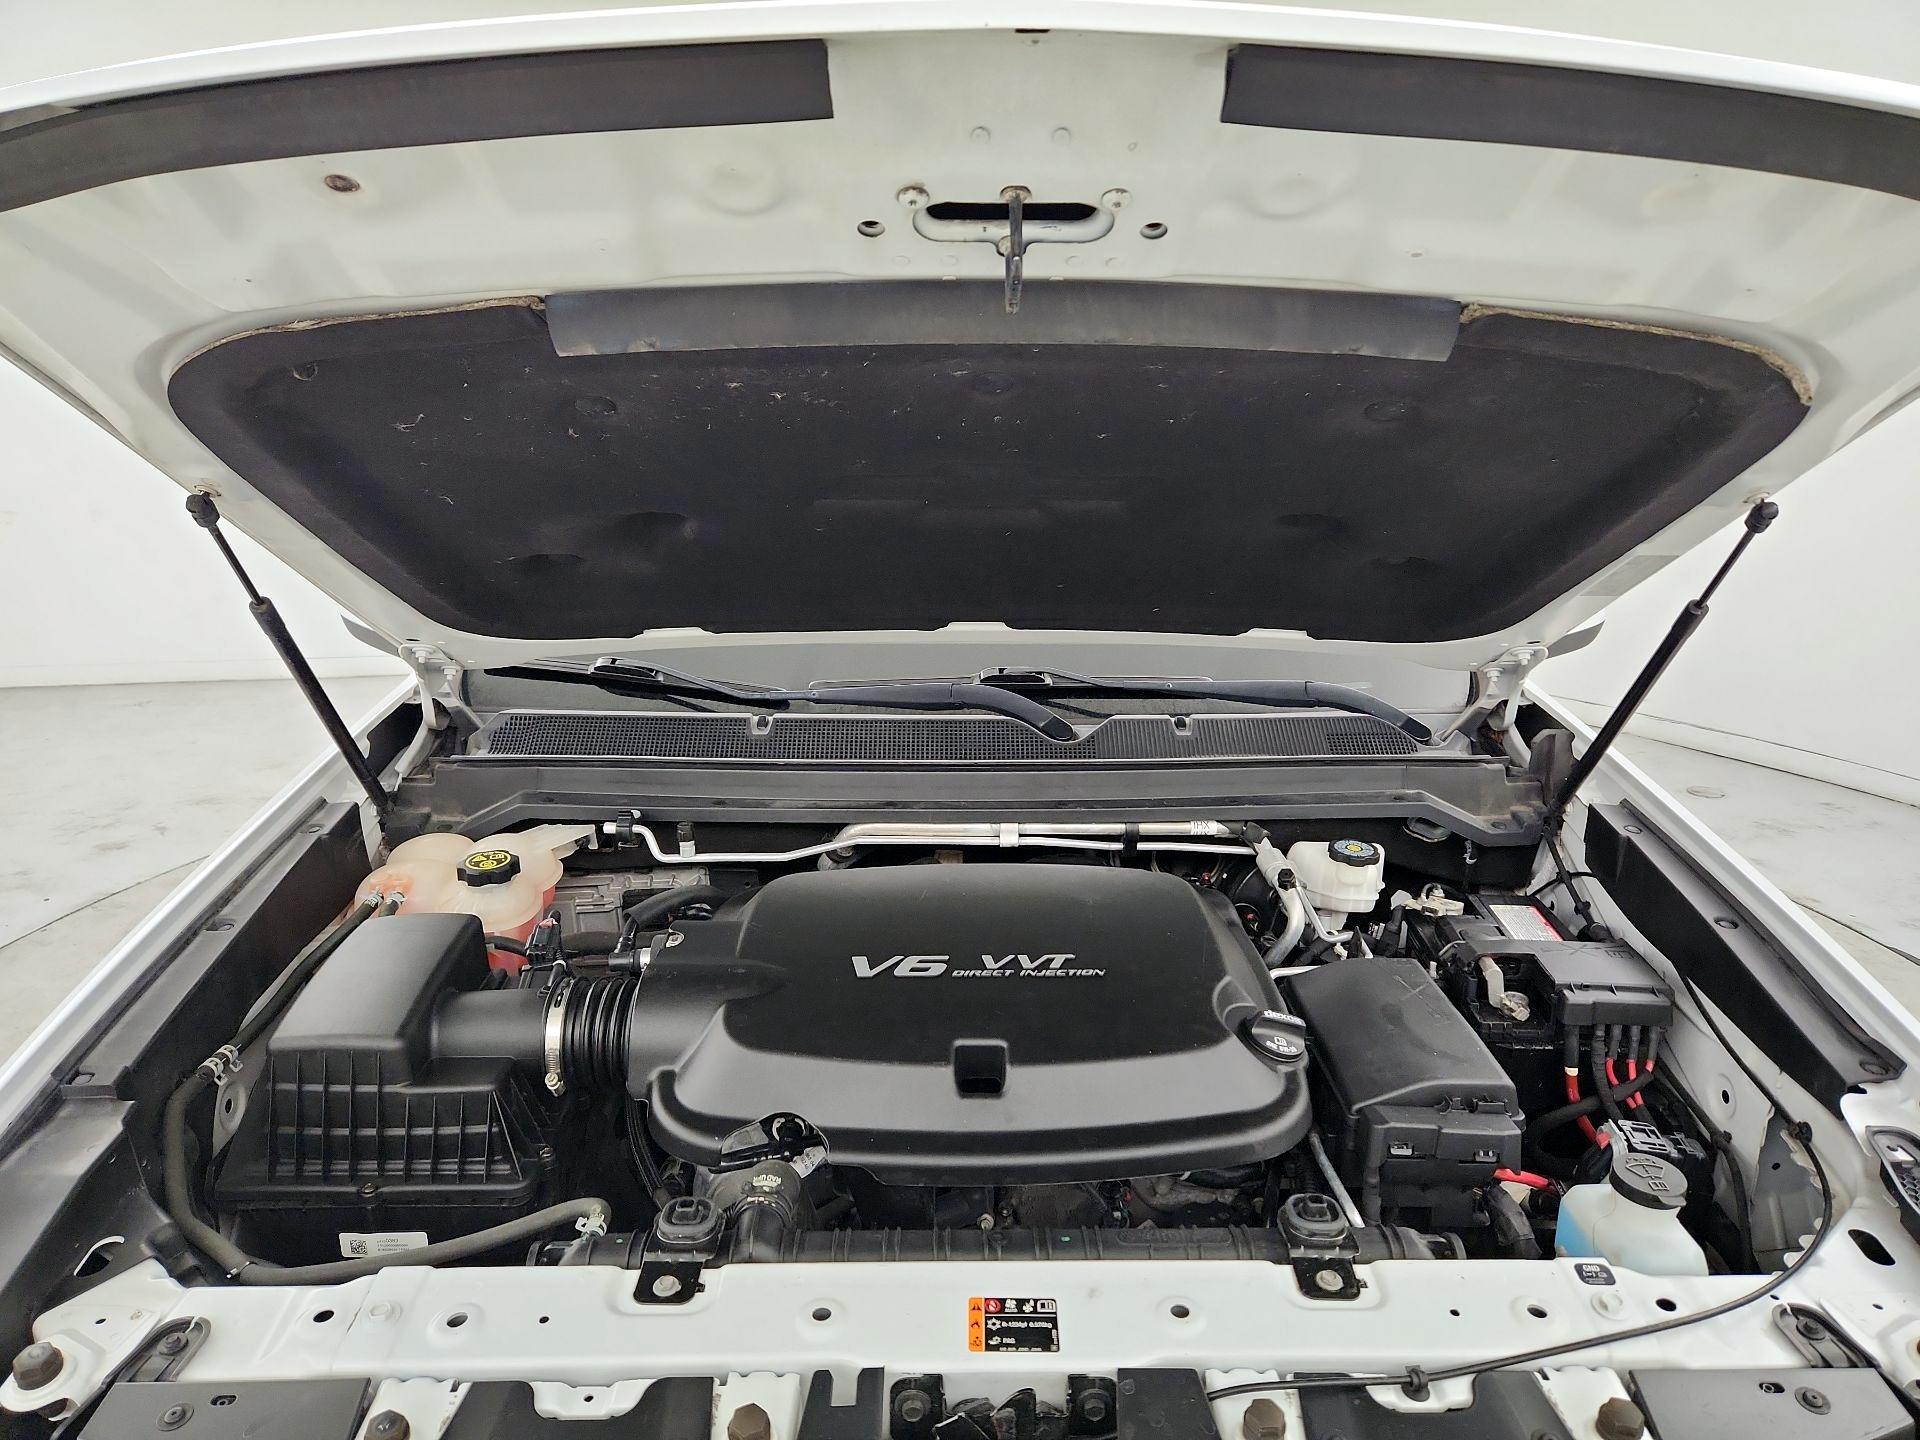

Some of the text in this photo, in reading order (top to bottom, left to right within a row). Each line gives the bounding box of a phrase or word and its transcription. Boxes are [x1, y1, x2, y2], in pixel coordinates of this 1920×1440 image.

[851, 954, 950, 978] V6
[981, 953, 1076, 970] VVT
[951, 968, 1106, 978] DIRECT INJECTION
[767, 1174, 782, 1185] RAD
